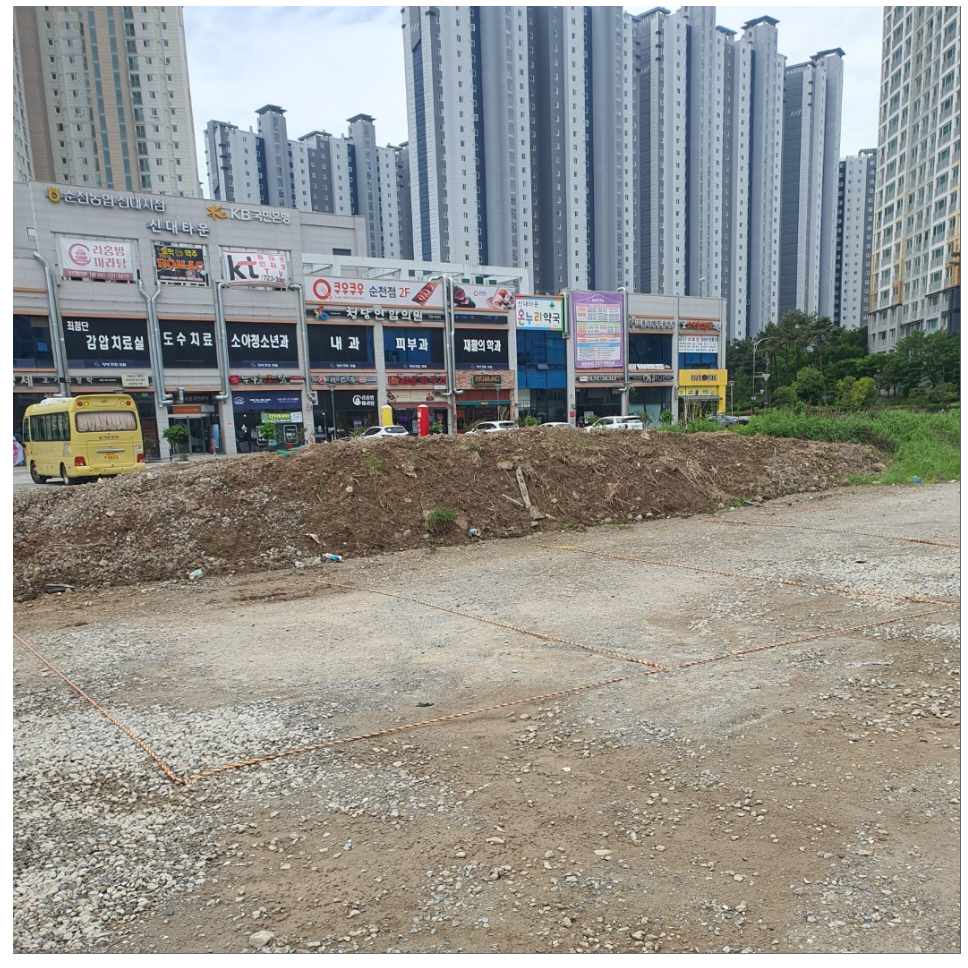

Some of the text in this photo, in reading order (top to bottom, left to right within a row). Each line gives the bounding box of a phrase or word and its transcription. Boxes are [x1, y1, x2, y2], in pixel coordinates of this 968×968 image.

[63, 190, 165, 212] 순천농협 신대지점
[149, 219, 210, 237] 신대타운
[93, 245, 125, 257] 라홍방
[94, 257, 127, 269] 마라탕
[227, 254, 259, 280] kt
[333, 282, 411, 298] 쿠우쿠우 순천점 2F
[517, 300, 539, 308] 신대타운
[518, 308, 560, 326] 온누리약국
[66, 320, 89, 332] 최첨단
[86, 335, 144, 351] 감압치료실
[163, 332, 213, 346] 도수치료
[230, 333, 289, 349] 소아청소년과
[330, 336, 360, 351] 내과
[395, 337, 429, 351] 피부과
